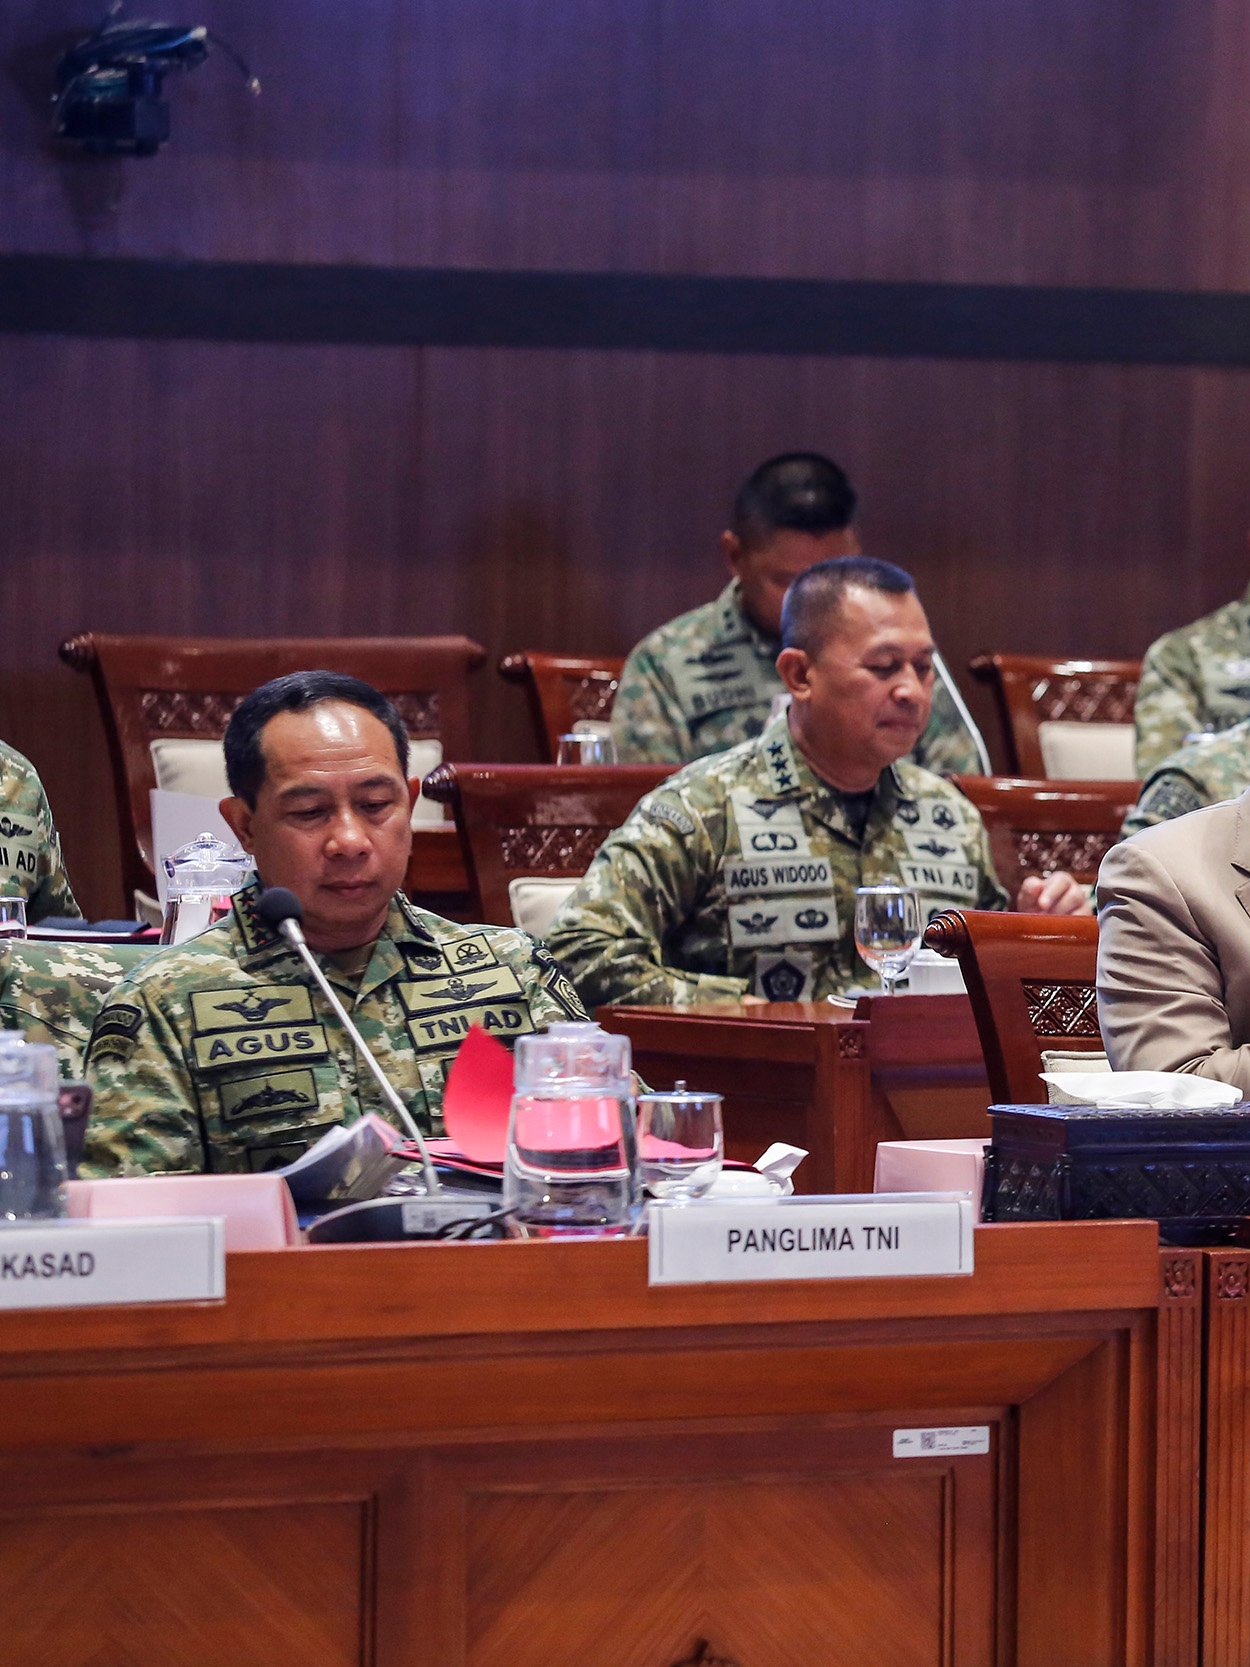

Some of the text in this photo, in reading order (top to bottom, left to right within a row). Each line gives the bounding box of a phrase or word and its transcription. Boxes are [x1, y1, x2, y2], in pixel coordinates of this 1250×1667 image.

[16, 850, 36, 873] AD
[730, 864, 828, 887] AGUS WIDODO
[907, 866, 974, 890] TNI AD
[420, 1009, 522, 1039] TNI AD
[209, 1031, 314, 1060] AGUS
[728, 1226, 899, 1252] PANGLIMA TNI
[1, 1251, 95, 1279] KASAD
